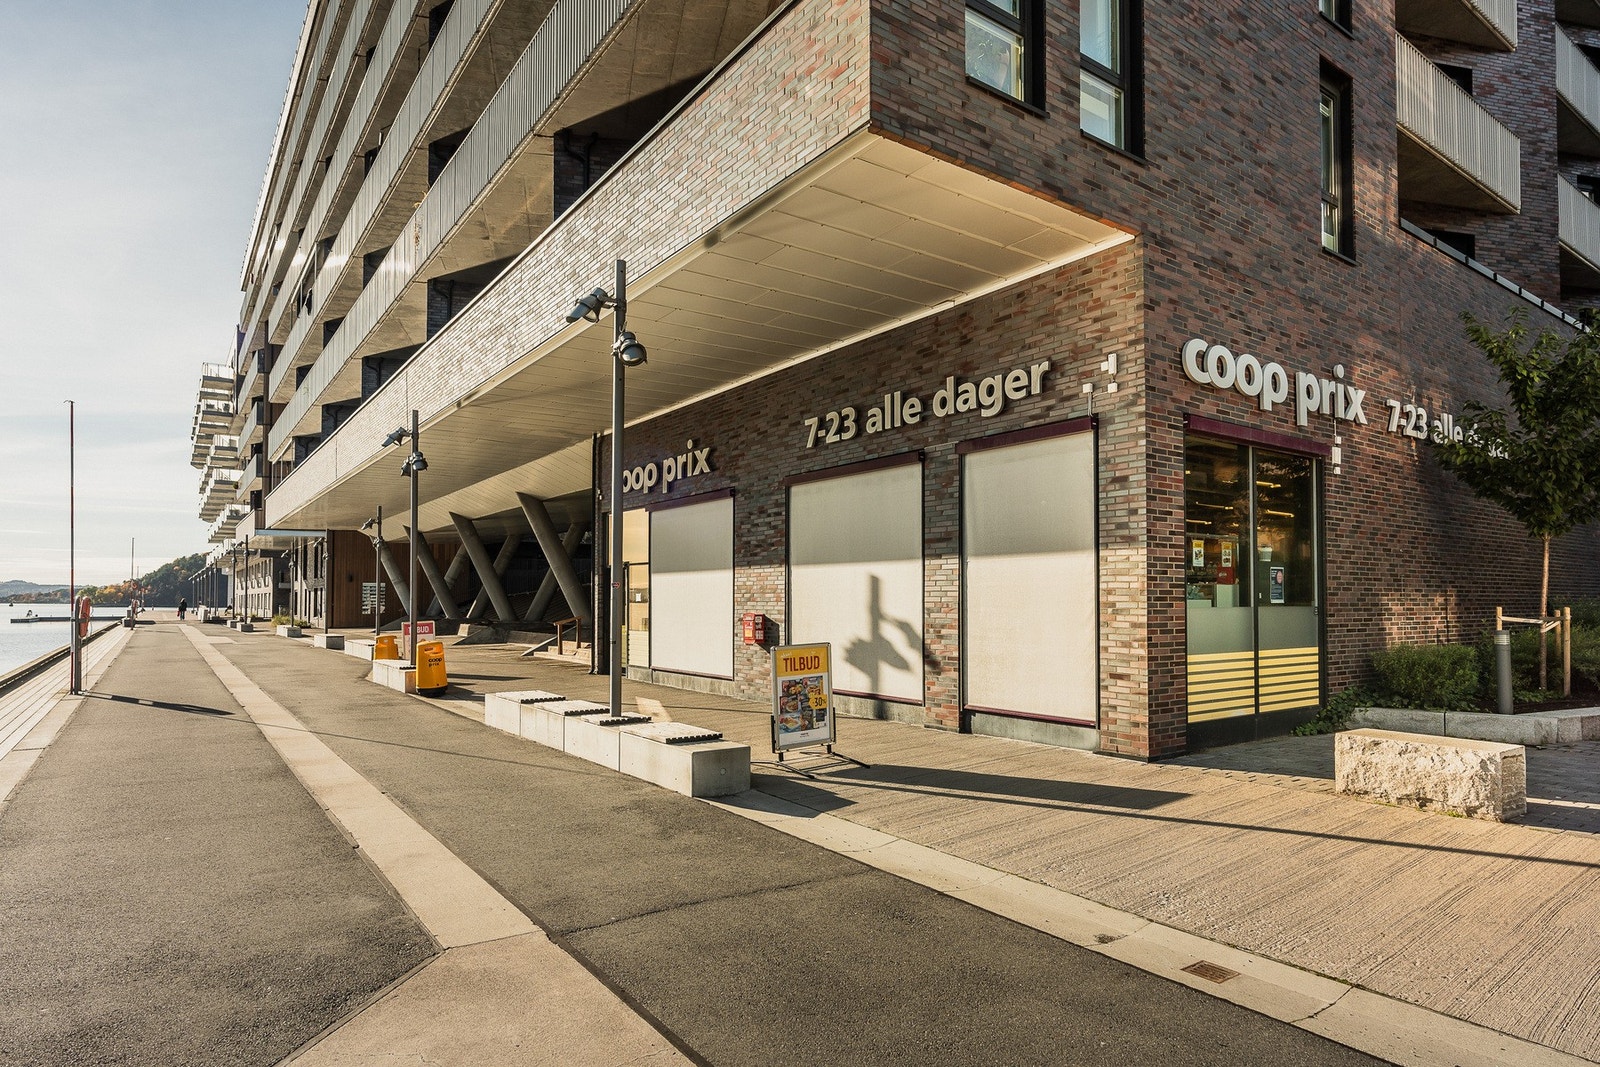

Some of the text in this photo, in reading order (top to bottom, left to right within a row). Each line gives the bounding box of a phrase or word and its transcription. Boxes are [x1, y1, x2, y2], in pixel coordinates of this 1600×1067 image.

[804, 360, 1050, 448] 7-23 alle dager
[1182, 338, 1368, 426] coop prix
[1386, 399, 1428, 440] 7-23
[622, 439, 711, 494] oop prix
[783, 656, 820, 672] TILBUD
